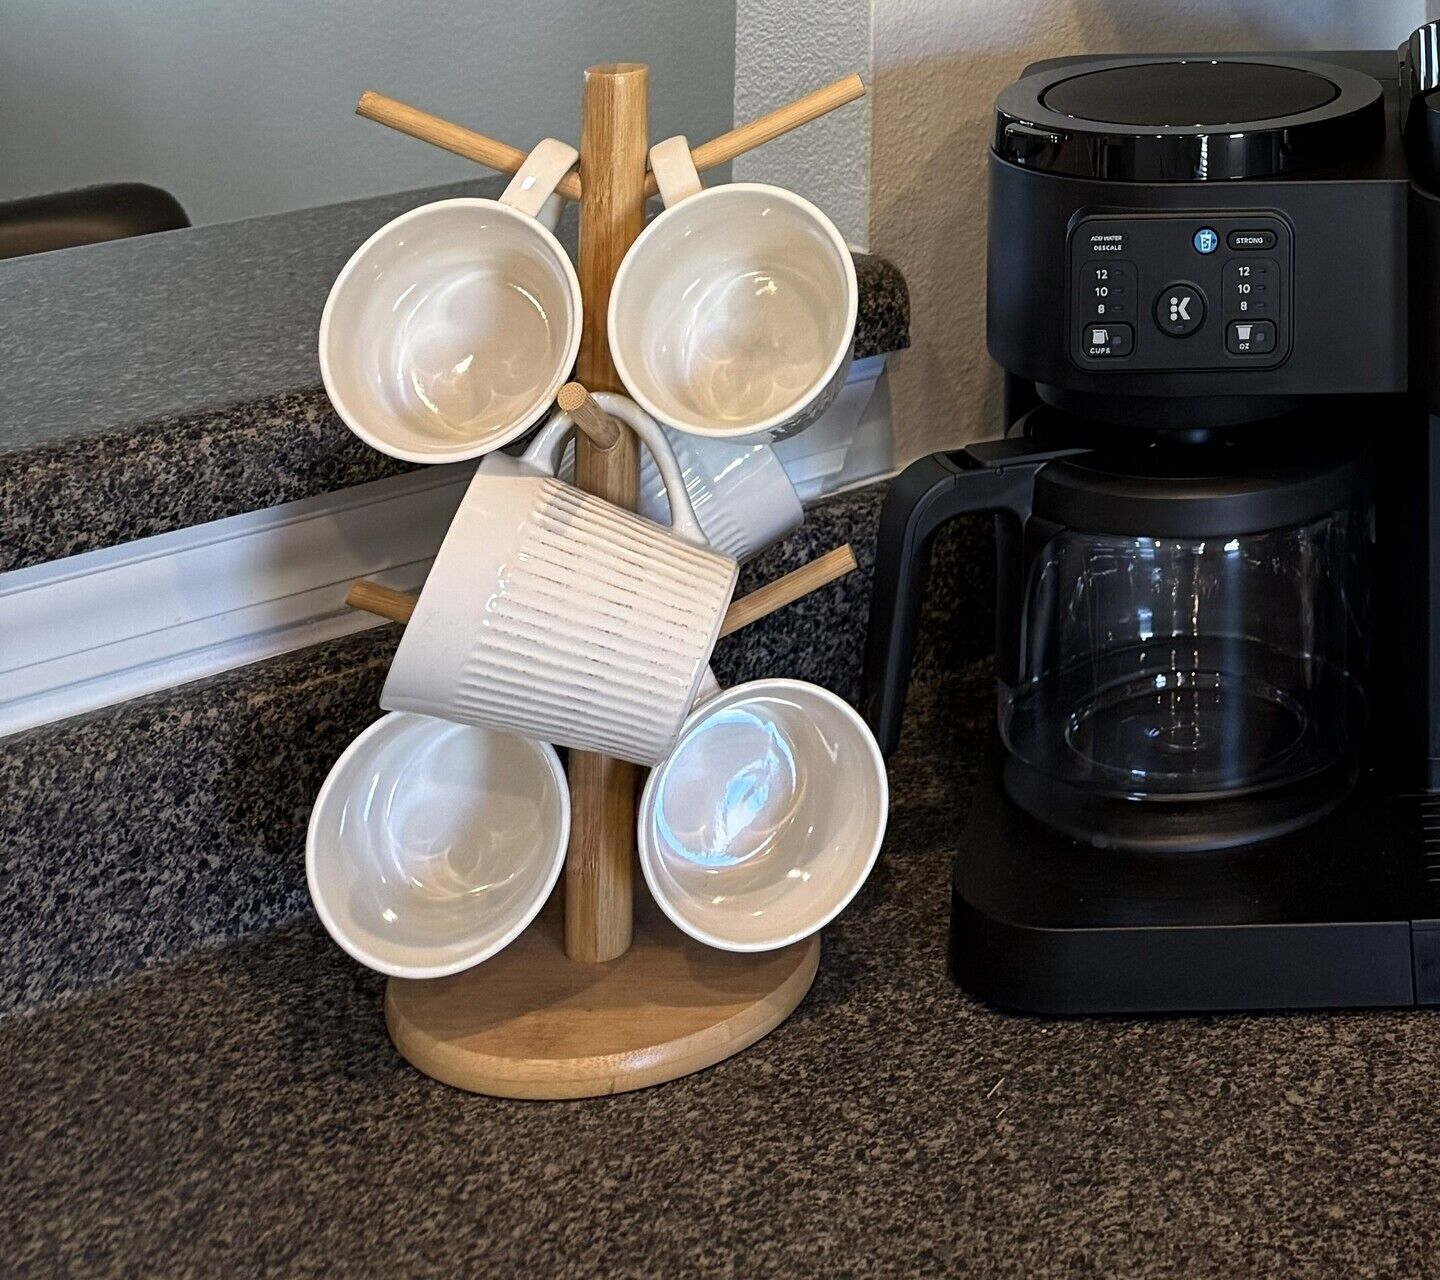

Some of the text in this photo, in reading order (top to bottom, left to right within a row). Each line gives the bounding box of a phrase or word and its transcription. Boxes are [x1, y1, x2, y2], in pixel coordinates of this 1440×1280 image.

[1235, 237, 1264, 245] STRONG
[1096, 269, 1108, 280] 12
[1238, 266, 1250, 277] 12
[1094, 287, 1108, 297] 10
[1237, 284, 1250, 294] 10
[1097, 304, 1105, 314] 8
[1240, 301, 1248, 311] 8
